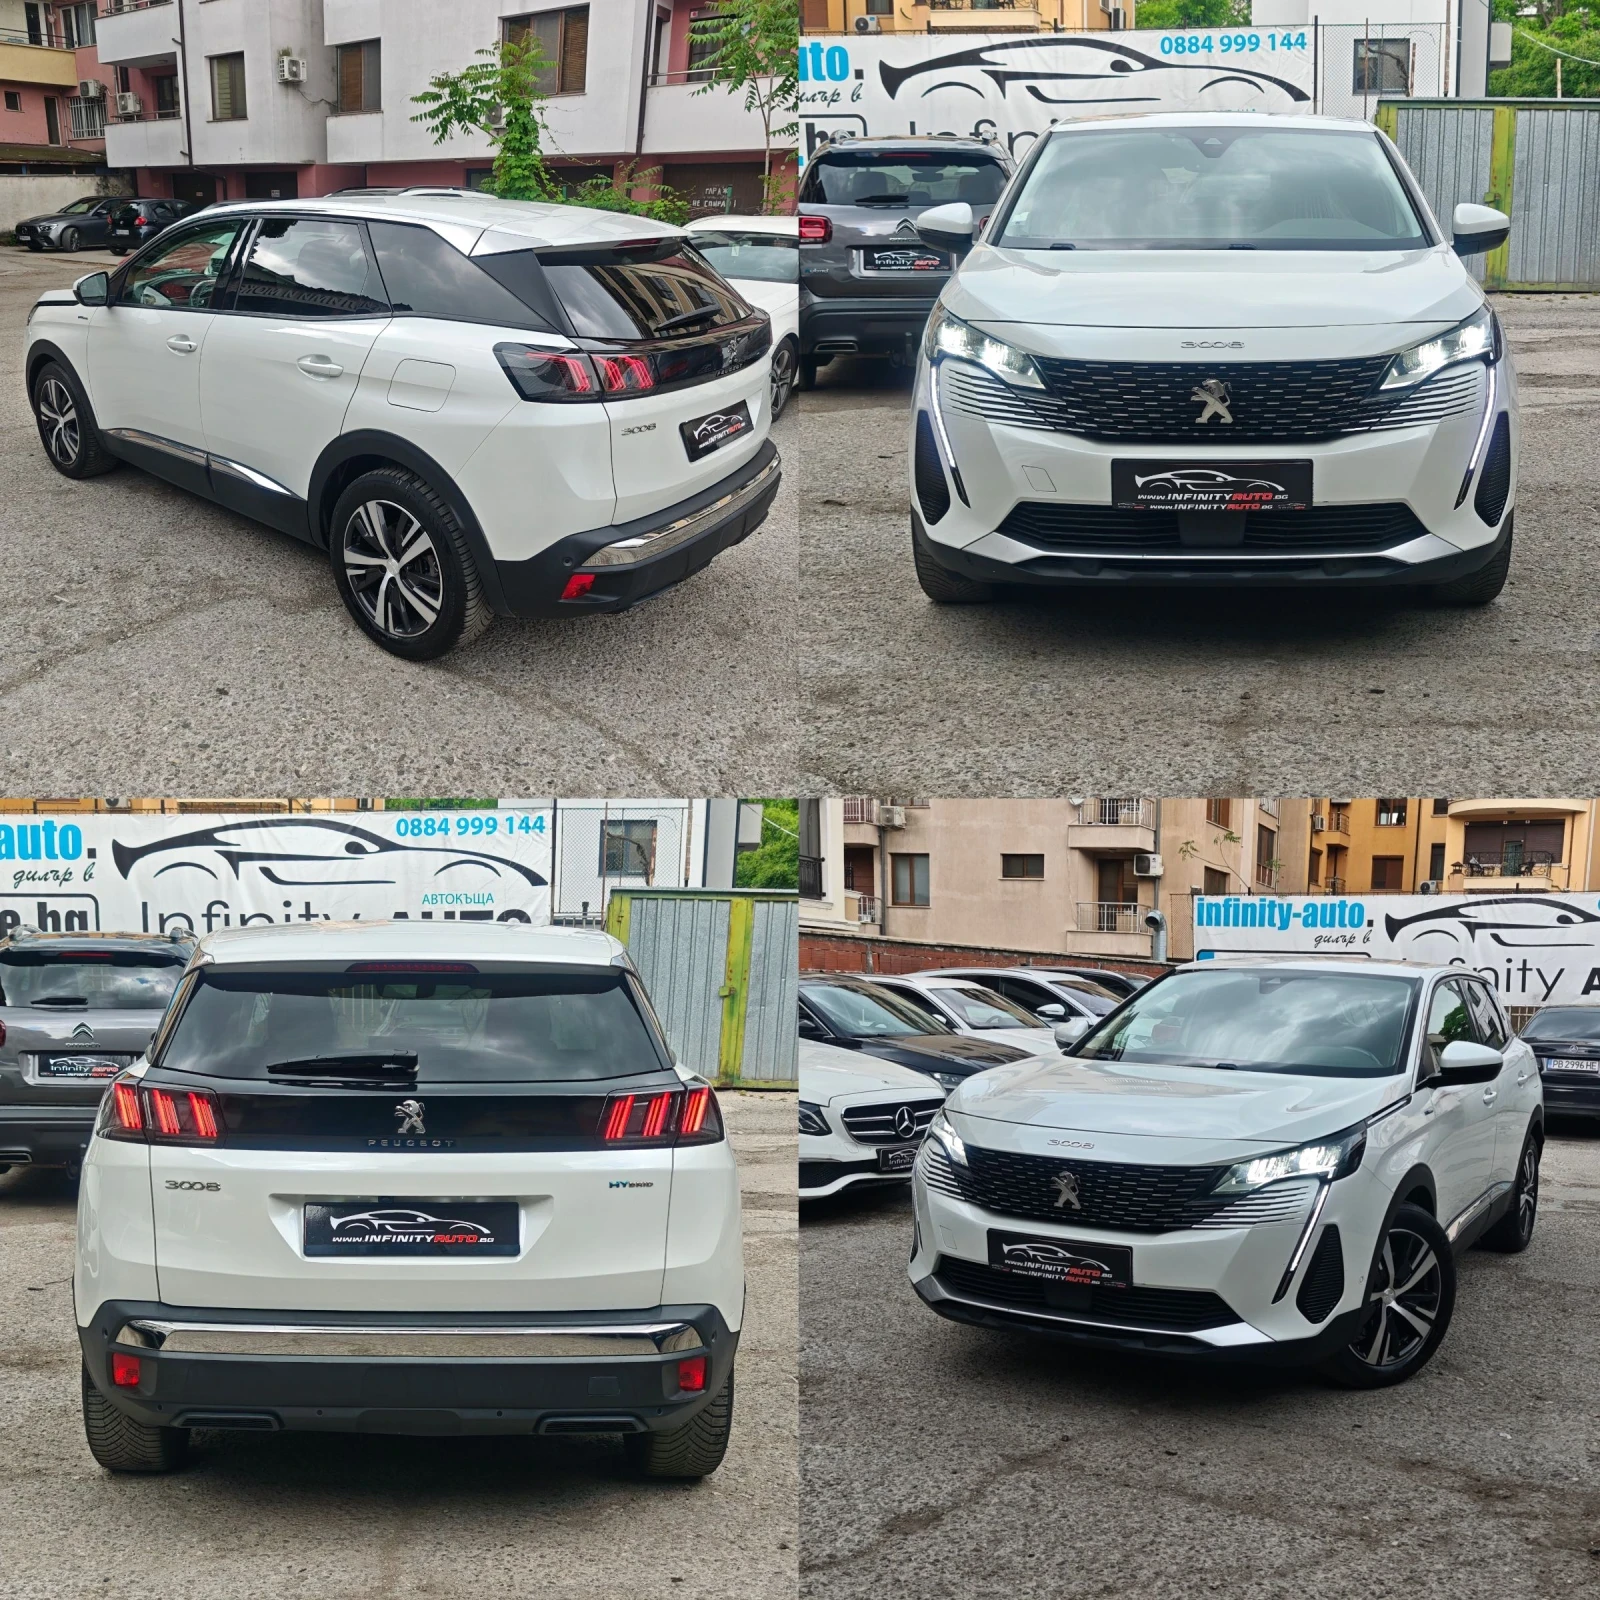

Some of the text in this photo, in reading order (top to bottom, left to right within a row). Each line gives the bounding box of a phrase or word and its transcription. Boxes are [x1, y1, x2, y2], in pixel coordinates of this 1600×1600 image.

[1160, 32, 1307, 55] 0884 999 144
[1181, 341, 1246, 349] 3008
[621, 422, 657, 436] 3008
[396, 815, 546, 837] 0884 999 144
[421, 892, 495, 906] АВТОКЪЩА
[1565, 1060, 1585, 1069] 2996
[367, 1139, 454, 1147] PEUGEOT
[1047, 1139, 1095, 1150] 3008
[165, 1180, 221, 1192] 3008
